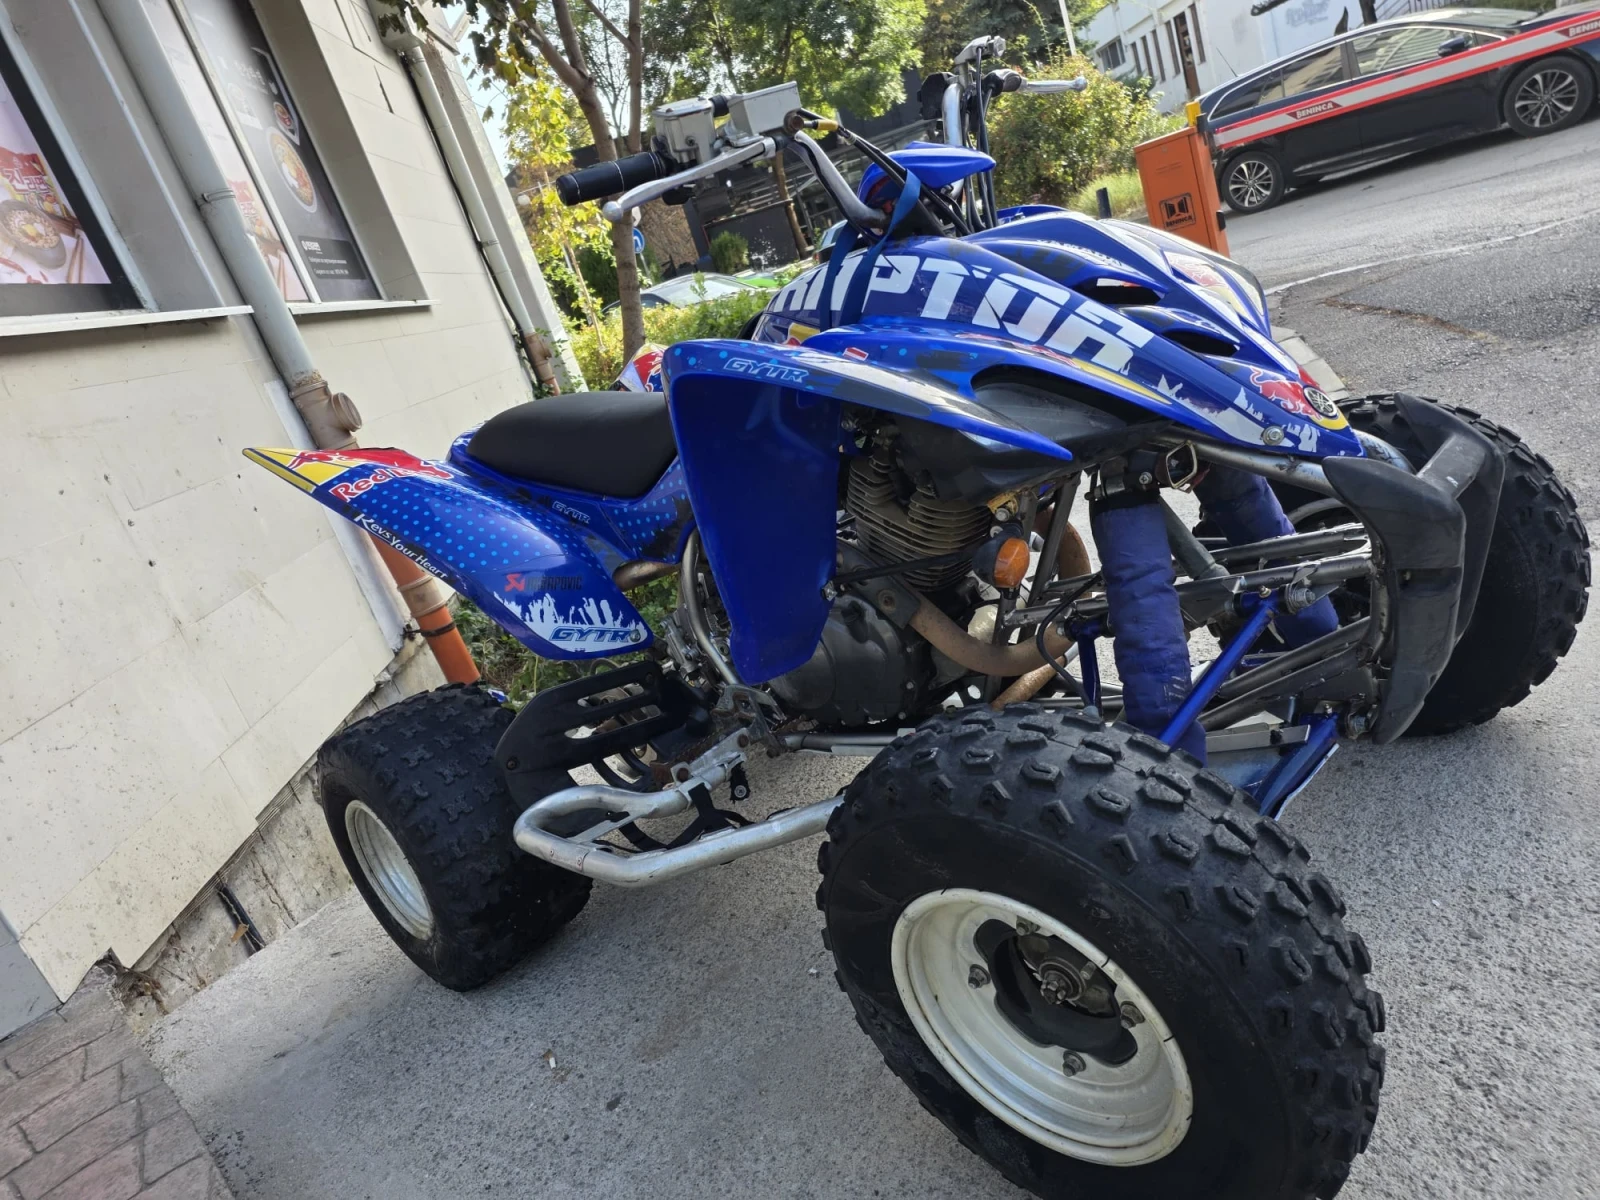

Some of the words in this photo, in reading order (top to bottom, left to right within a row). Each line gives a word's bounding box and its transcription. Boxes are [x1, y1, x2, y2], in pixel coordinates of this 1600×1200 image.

[1296, 102, 1334, 119] BENINCA
[723, 357, 810, 383] GYTR
[328, 468, 393, 503] Red
[549, 626, 632, 643] GYTR
